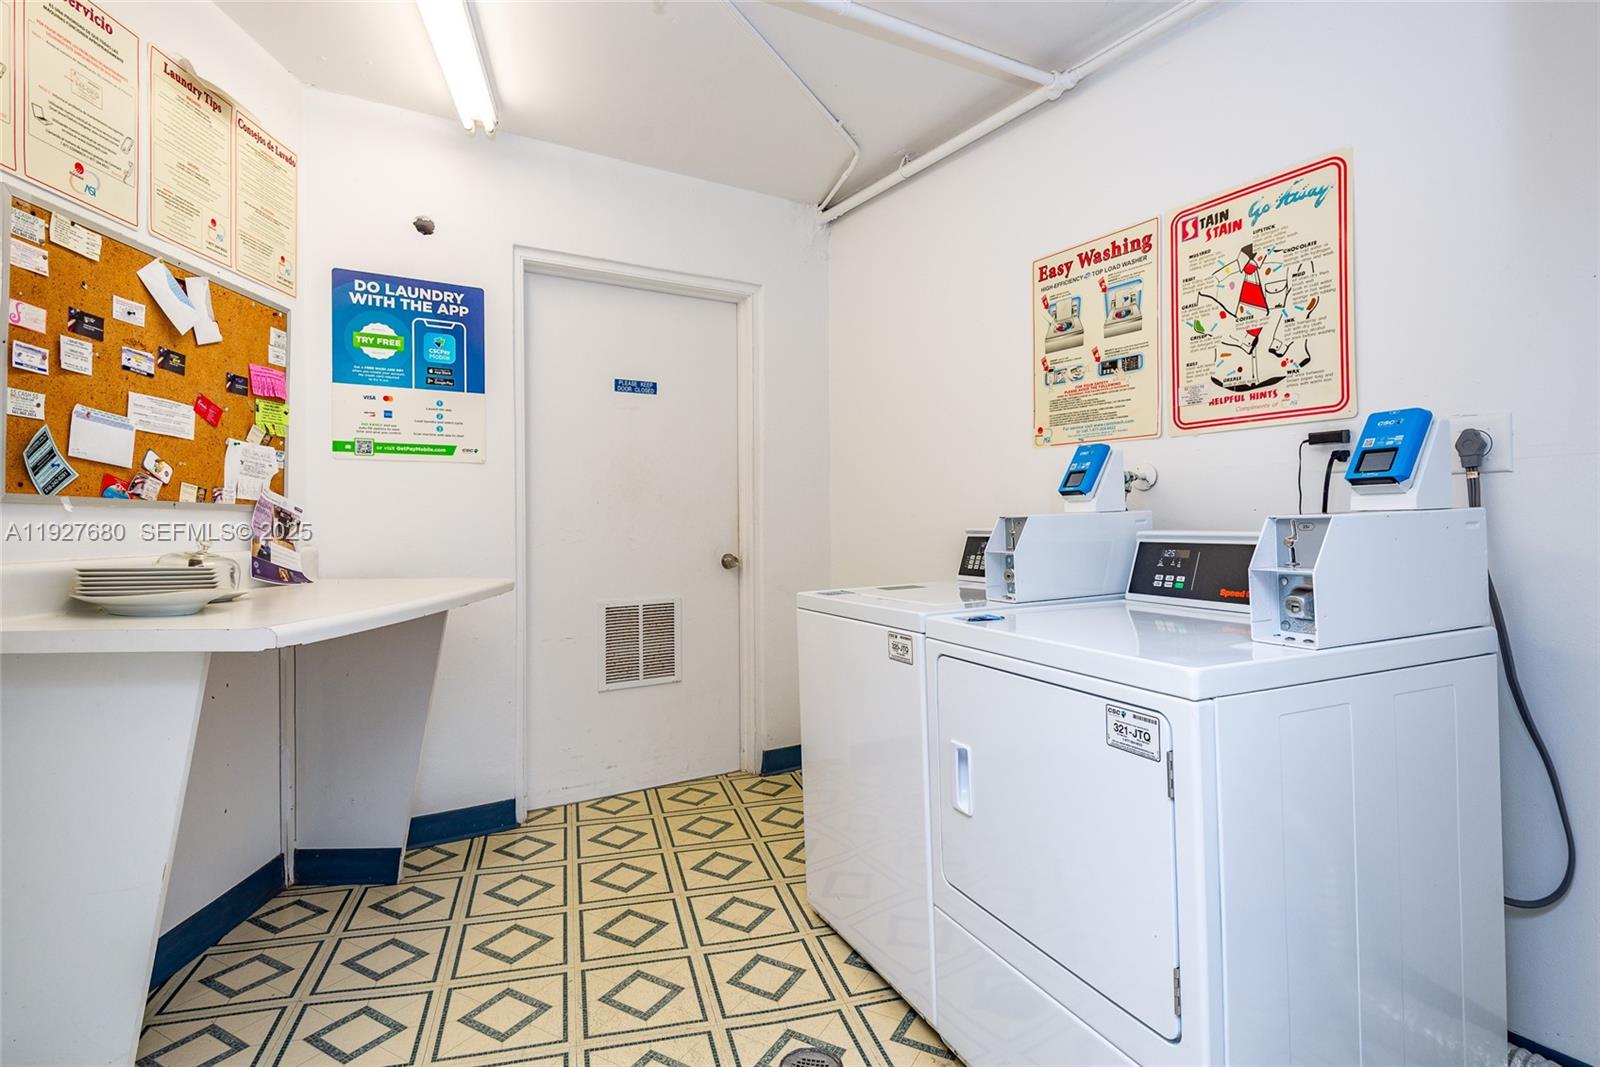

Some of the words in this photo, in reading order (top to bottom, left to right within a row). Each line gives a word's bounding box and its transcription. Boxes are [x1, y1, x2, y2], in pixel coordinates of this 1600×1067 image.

[63, 0, 114, 36] ervicio
[163, 62, 202, 100] Laundry
[203, 91, 222, 114] Tips
[237, 118, 266, 148] Consejos
[266, 142, 274, 153] de
[274, 146, 296, 168] Lavado
[1248, 197, 1271, 227] Go
[1275, 183, 1329, 208] Away
[1205, 219, 1243, 242] STAIN
[1252, 223, 1276, 235] LIPSTICK
[1283, 239, 1317, 253] CHOCOLATE
[1038, 260, 1074, 282] Easy
[1077, 234, 1153, 269] Washing
[1092, 268, 1105, 277] TOP
[1104, 264, 1121, 274] LOAD
[1121, 255, 1148, 268] WASHER
[1182, 276, 1196, 284] FRUIT
[354, 279, 380, 294] DO
[385, 283, 464, 304] LAUNDRY
[348, 292, 395, 309] WITH
[400, 298, 432, 313] THE
[437, 303, 469, 317] APP
[356, 335, 374, 344] TRY
[377, 337, 401, 346] FREE
[1209, 394, 1245, 406] HELPFUL
[1249, 388, 1278, 401] HINTS
[1219, 588, 1247, 599] Speed
[1113, 722, 1151, 743] 321-JTQ
